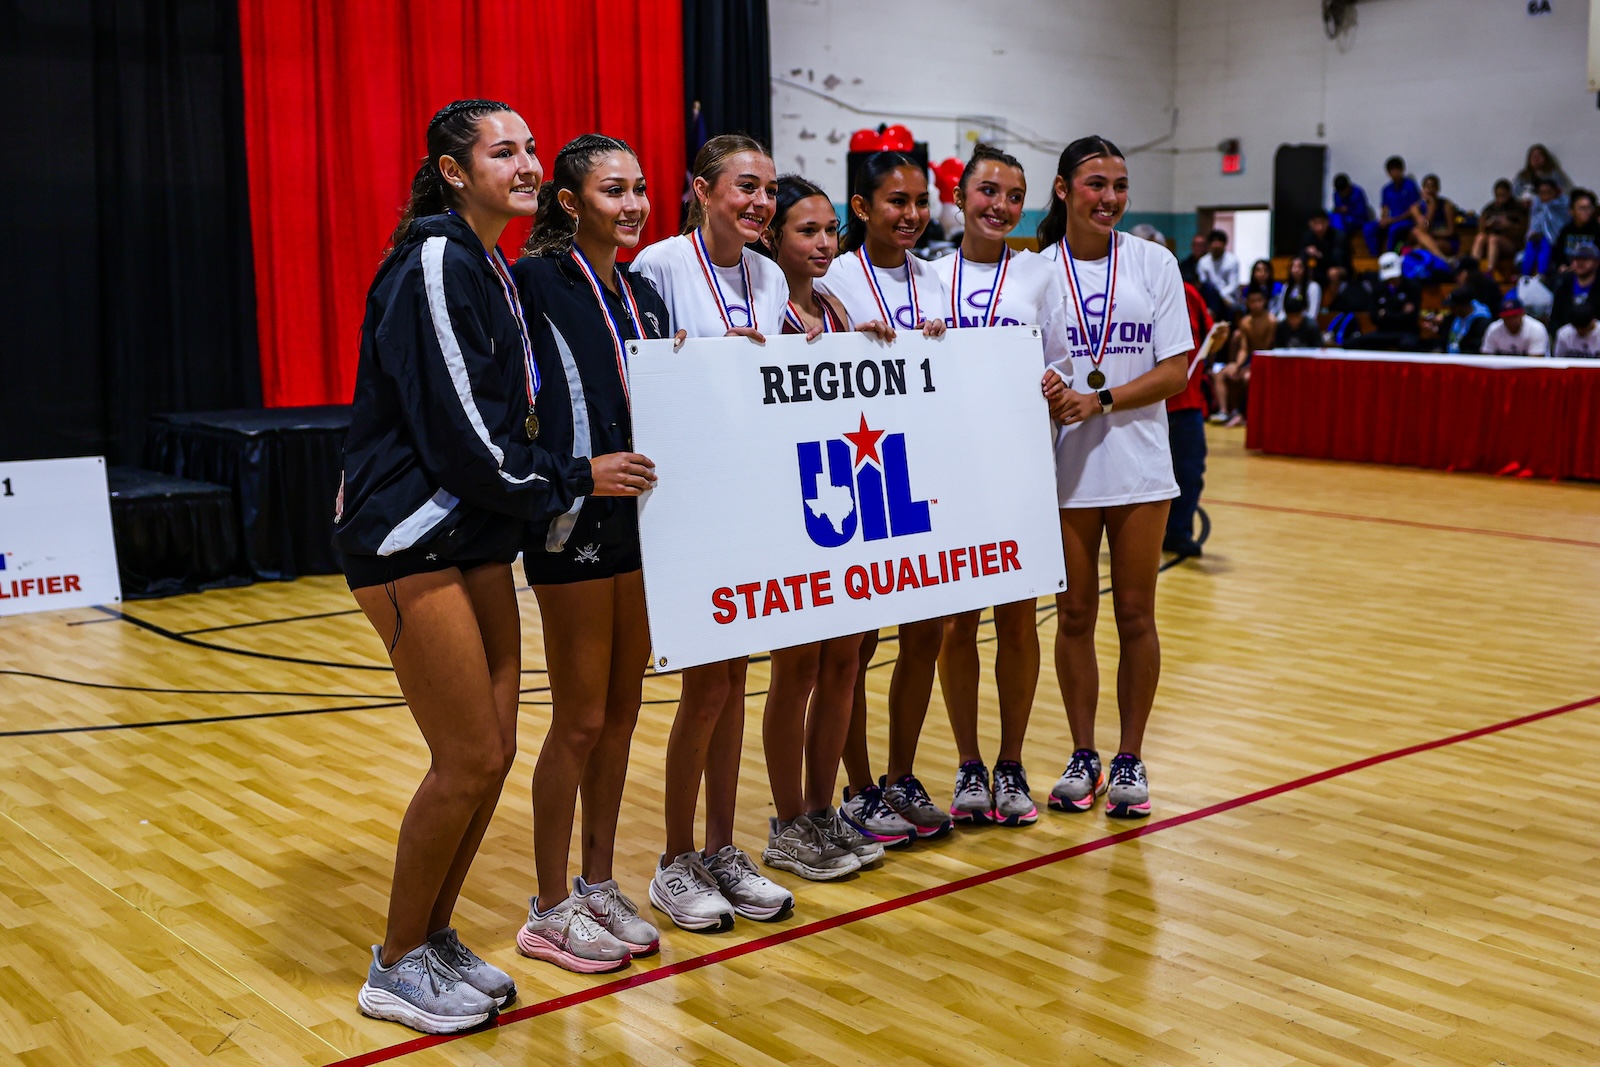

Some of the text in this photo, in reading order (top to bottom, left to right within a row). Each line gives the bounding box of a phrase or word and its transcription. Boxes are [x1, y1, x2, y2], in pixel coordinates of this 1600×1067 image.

[761, 358, 936, 404] REGION 1
[2, 477, 15, 497] 1
[796, 433, 932, 548] UIL
[712, 540, 1022, 625] STATE QUALIFIER
